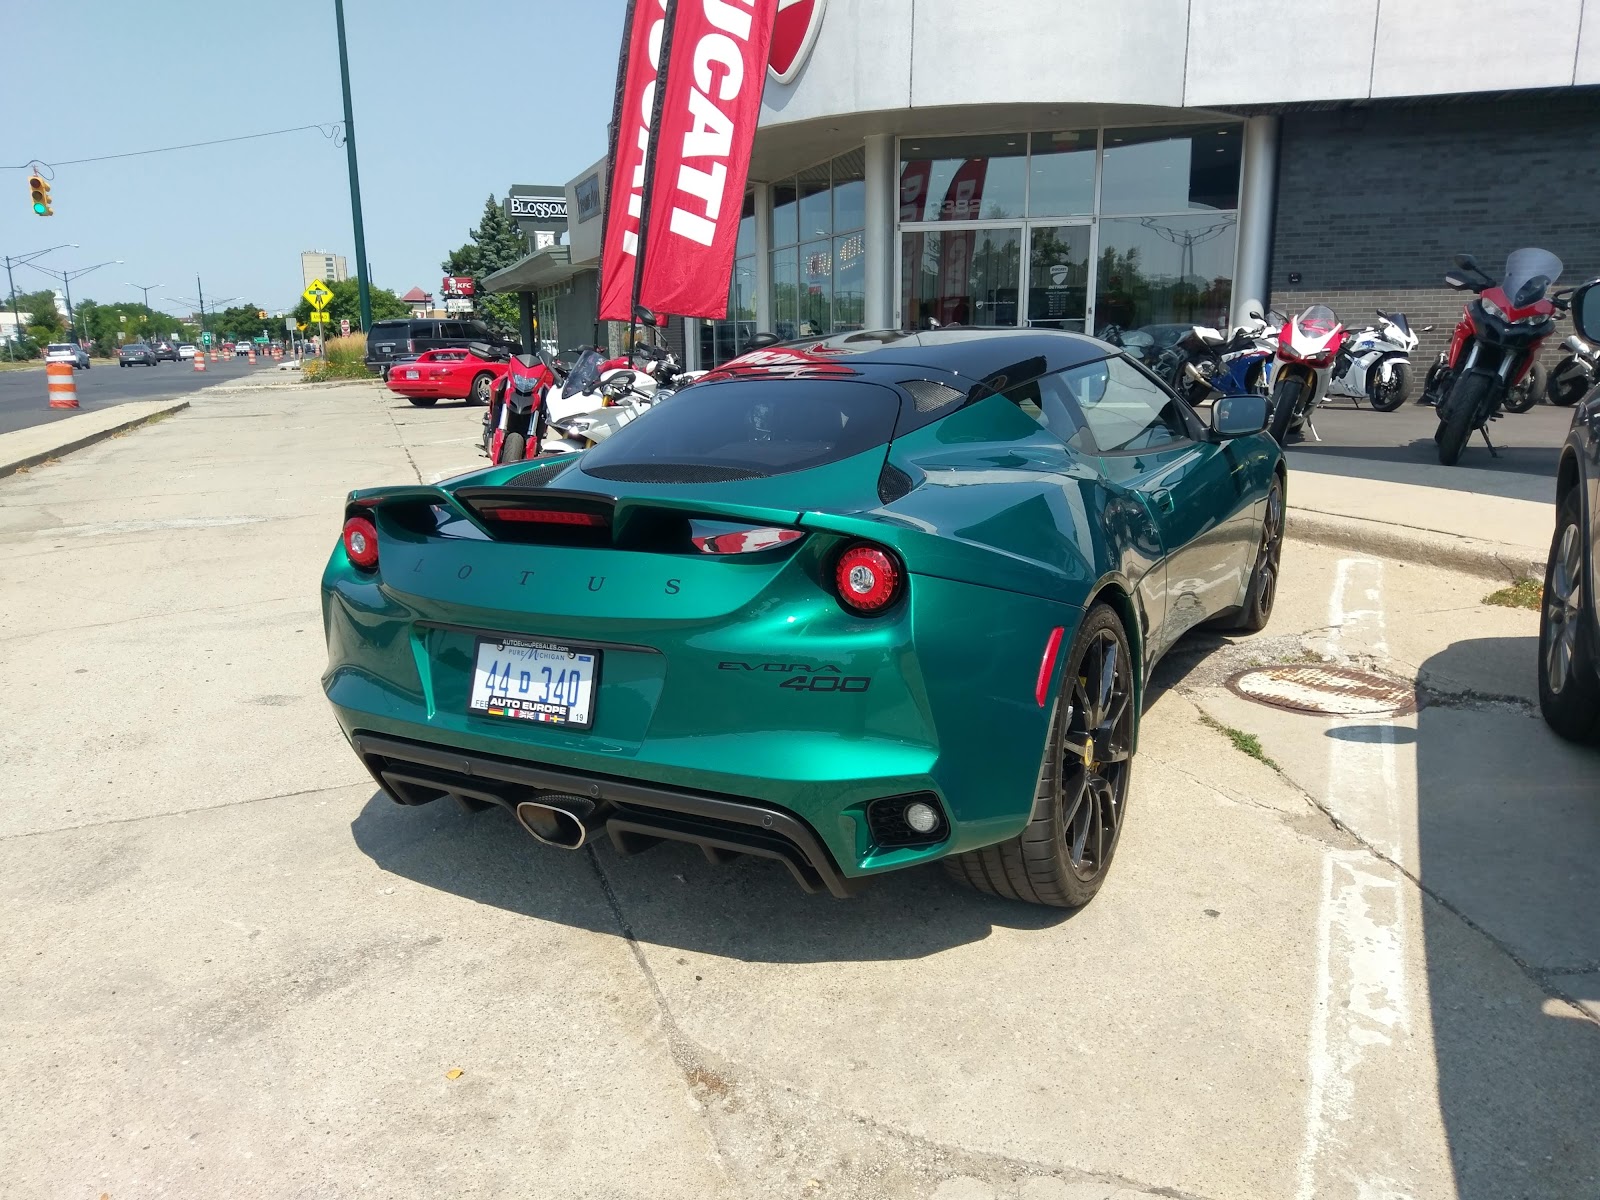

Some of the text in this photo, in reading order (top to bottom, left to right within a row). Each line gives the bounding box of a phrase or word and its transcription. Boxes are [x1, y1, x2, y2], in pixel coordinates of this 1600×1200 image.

[413, 558, 681, 595] LOTUS
[508, 648, 565, 661] PURE MICHIGAN
[718, 661, 842, 673] EVORA
[485, 660, 511, 697] 44
[538, 666, 581, 707] 340
[779, 675, 872, 692] 400
[490, 697, 567, 715] AUTO EUROPE
[575, 713, 584, 722] 19
